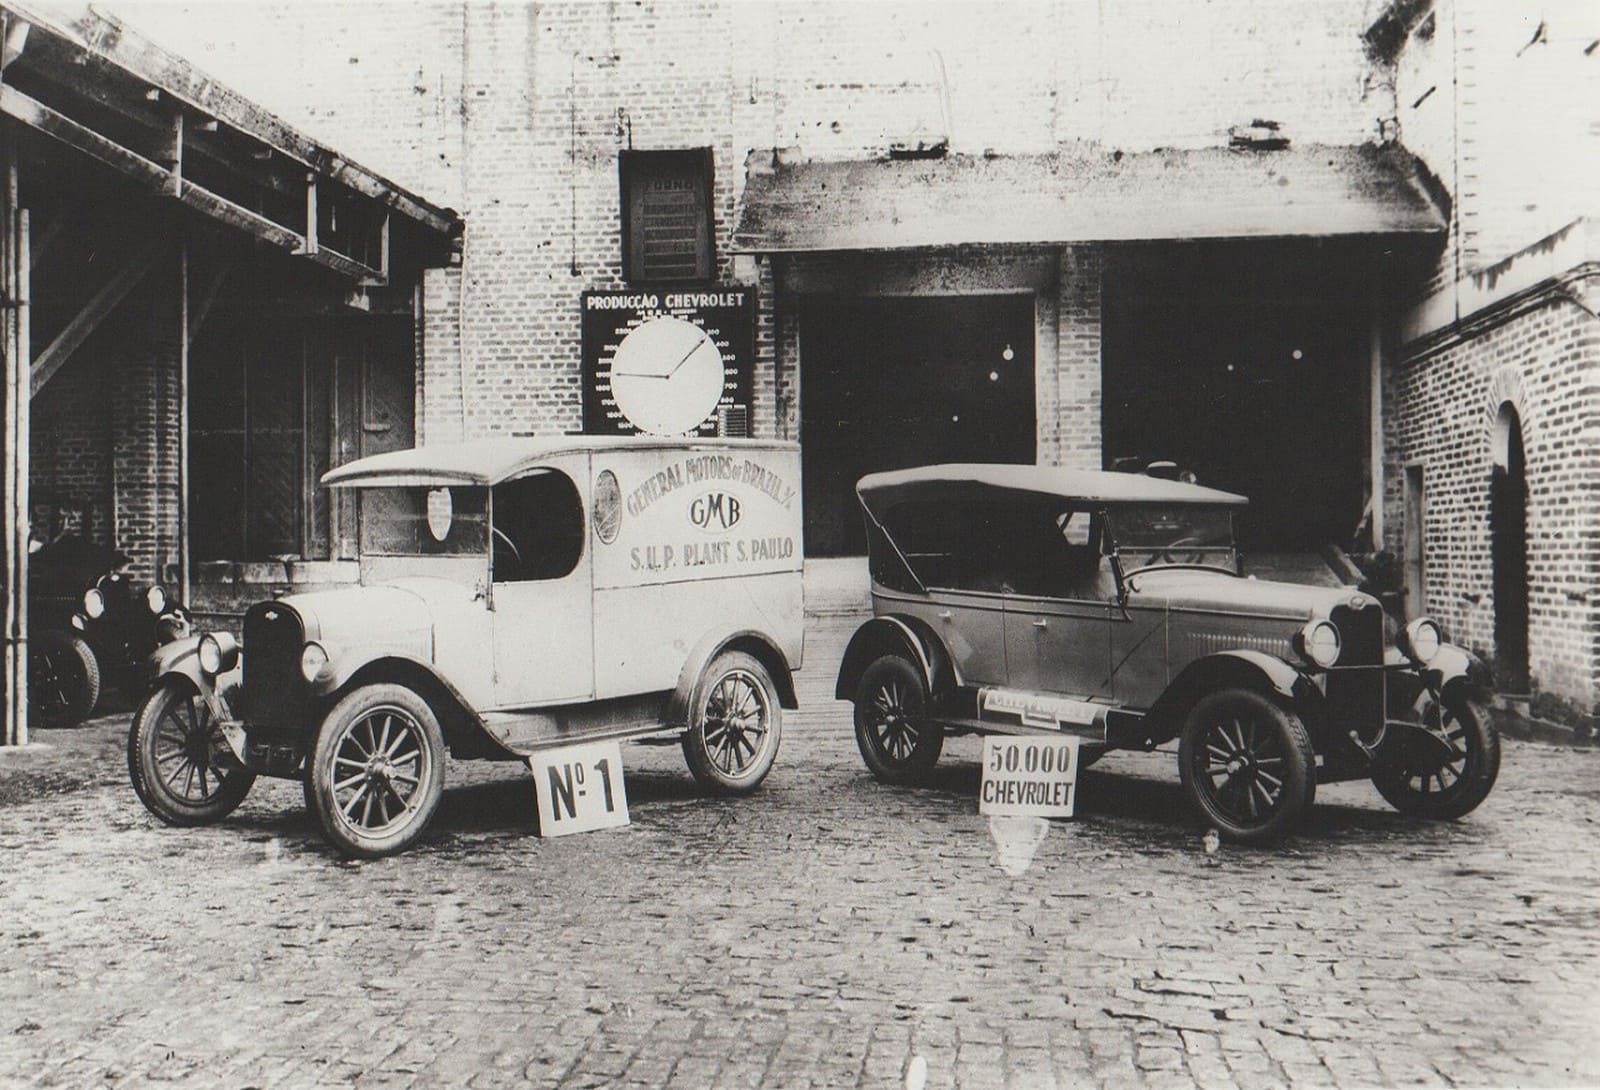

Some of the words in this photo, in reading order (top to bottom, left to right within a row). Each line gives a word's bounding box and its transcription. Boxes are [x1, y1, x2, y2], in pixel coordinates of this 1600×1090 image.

[665, 293, 744, 308] CHEVROLET
[627, 463, 684, 518] GENERAL
[685, 455, 733, 484] MOTORS
[690, 493, 741, 529] GMB
[684, 541, 732, 567] PLANT
[990, 744, 1070, 773] 50.000
[593, 758, 614, 812] 1
[983, 780, 1073, 806] CHEVROLET
